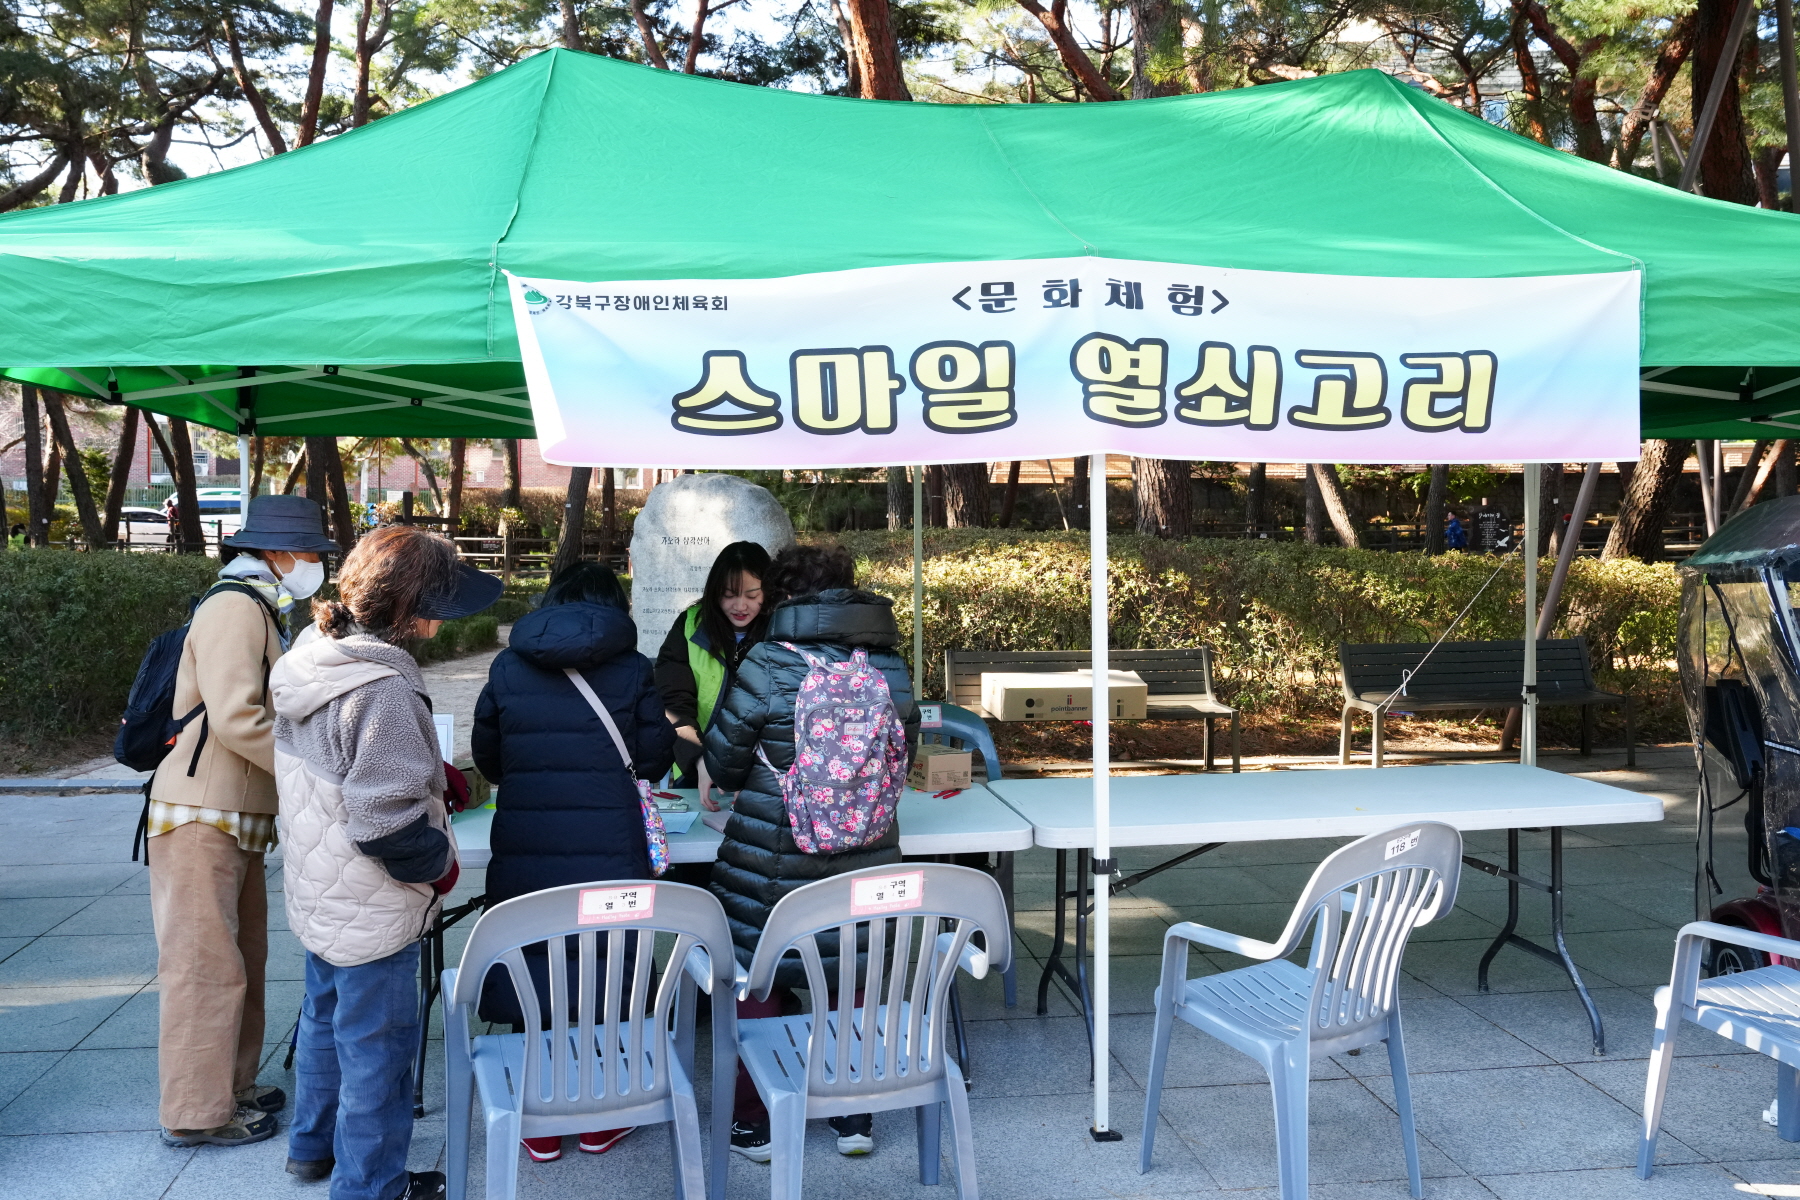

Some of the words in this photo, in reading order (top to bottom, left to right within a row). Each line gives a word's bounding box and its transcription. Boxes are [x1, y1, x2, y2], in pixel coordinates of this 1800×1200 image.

[555, 293, 728, 312] 강북구장애인체육회
[671, 339, 1018, 436] 스마일
[1069, 330, 1498, 434] 열쇠고리
[1050, 705, 1088, 713] pointbanner
[1391, 842, 1405, 854] 118
[890, 879, 906, 889] 구역
[620, 891, 637, 900] 구역
[897, 888, 906, 898] 번
[628, 899, 637, 908] 번
